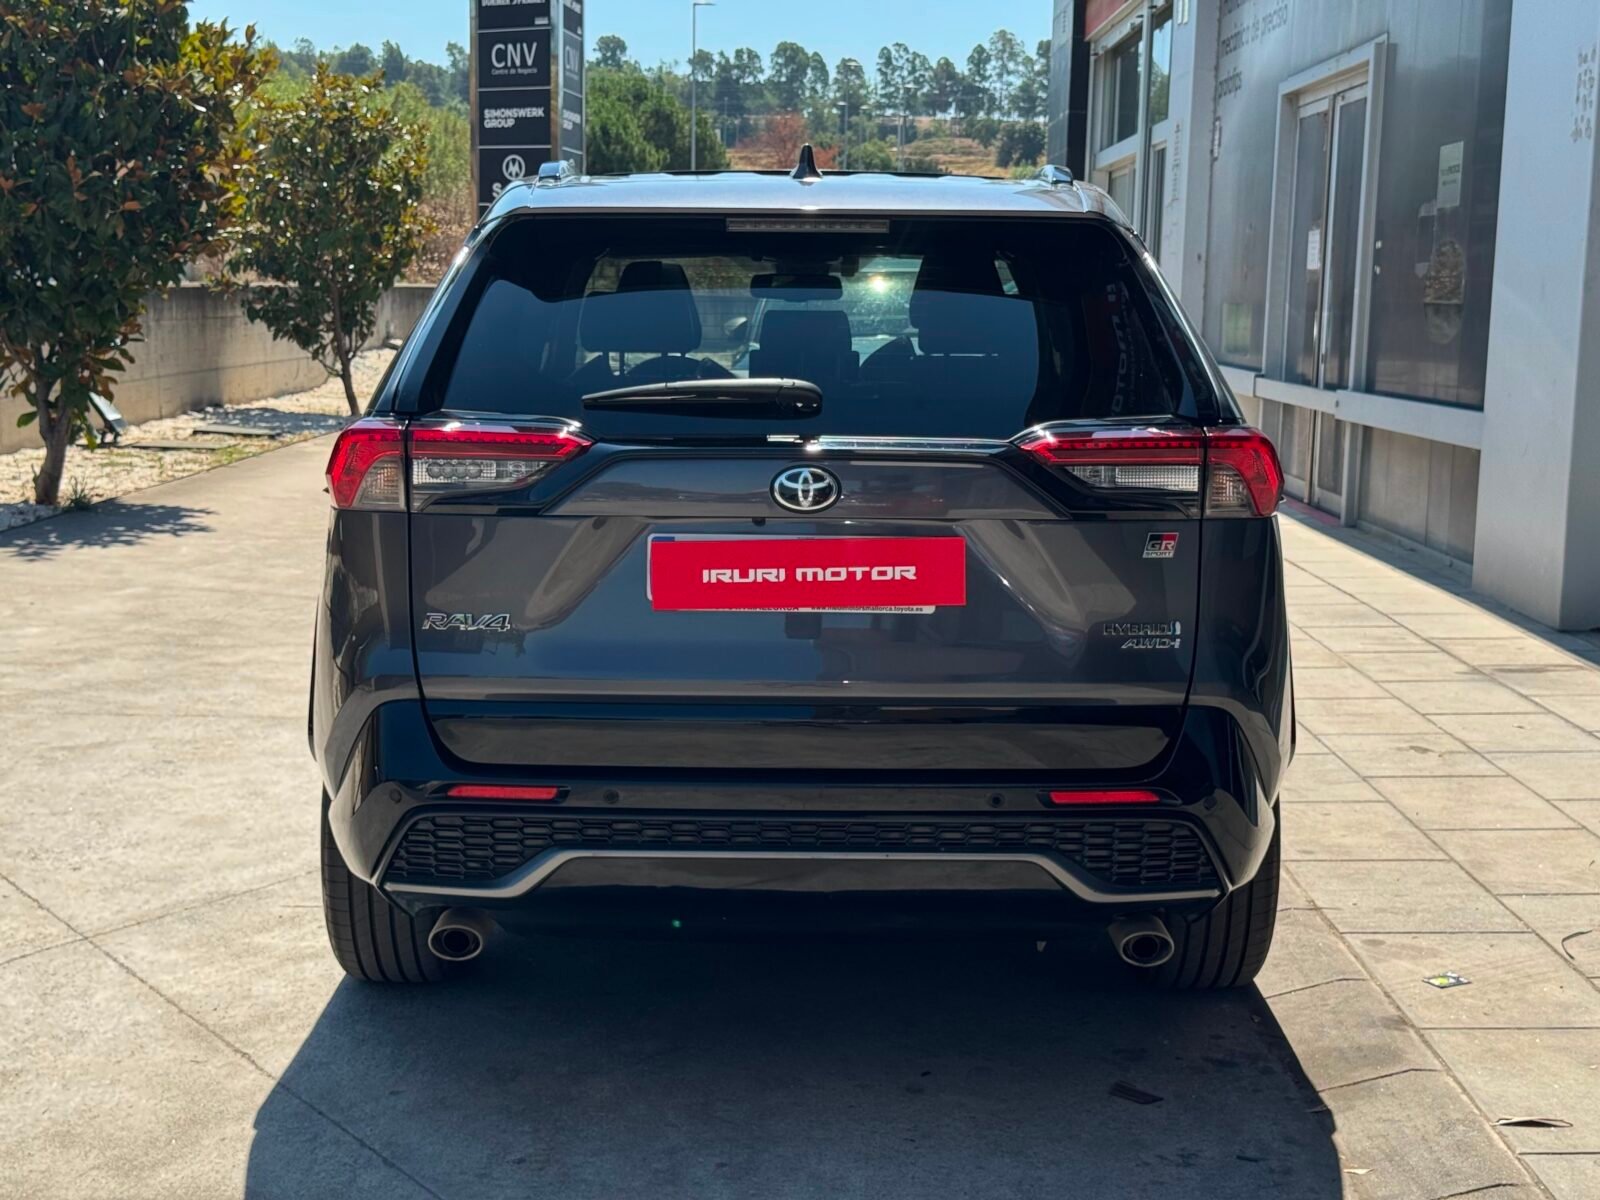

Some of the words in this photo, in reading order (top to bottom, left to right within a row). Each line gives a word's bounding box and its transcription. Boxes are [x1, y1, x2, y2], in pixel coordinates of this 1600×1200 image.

[491, 42, 537, 68] CNV
[484, 107, 544, 118] SIMONSWERK
[484, 119, 515, 128] GROUP
[1147, 540, 1175, 551] GR
[422, 612, 511, 631] RAV4
[1103, 623, 1168, 636] HYBRID
